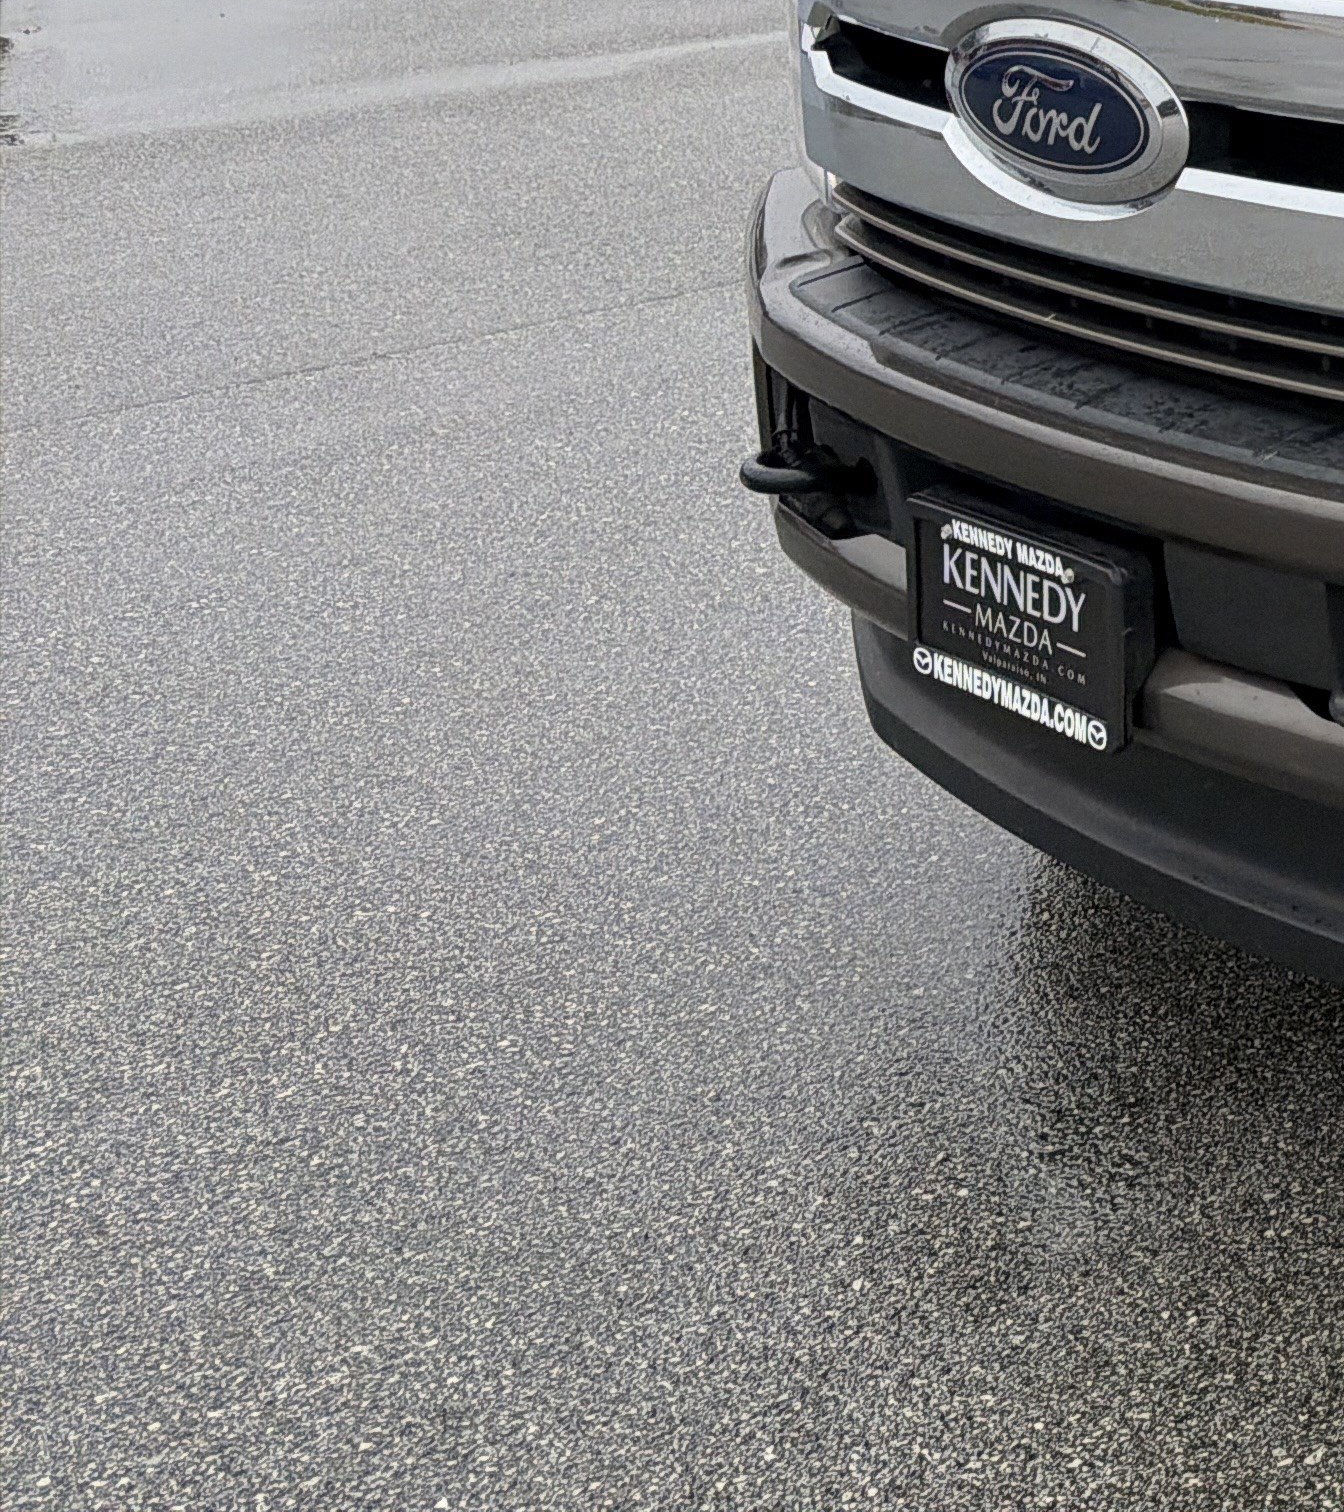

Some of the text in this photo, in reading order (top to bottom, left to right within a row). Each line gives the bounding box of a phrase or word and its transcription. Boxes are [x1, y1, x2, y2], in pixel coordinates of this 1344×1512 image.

[992, 63, 1104, 156] Ford
[942, 542, 1086, 633] KENNEDY
[951, 518, 1064, 577] KENNEDY MAZDA
[974, 602, 1053, 656] MAZDA
[933, 651, 1088, 745] KENNEDYMAZDA.COM
